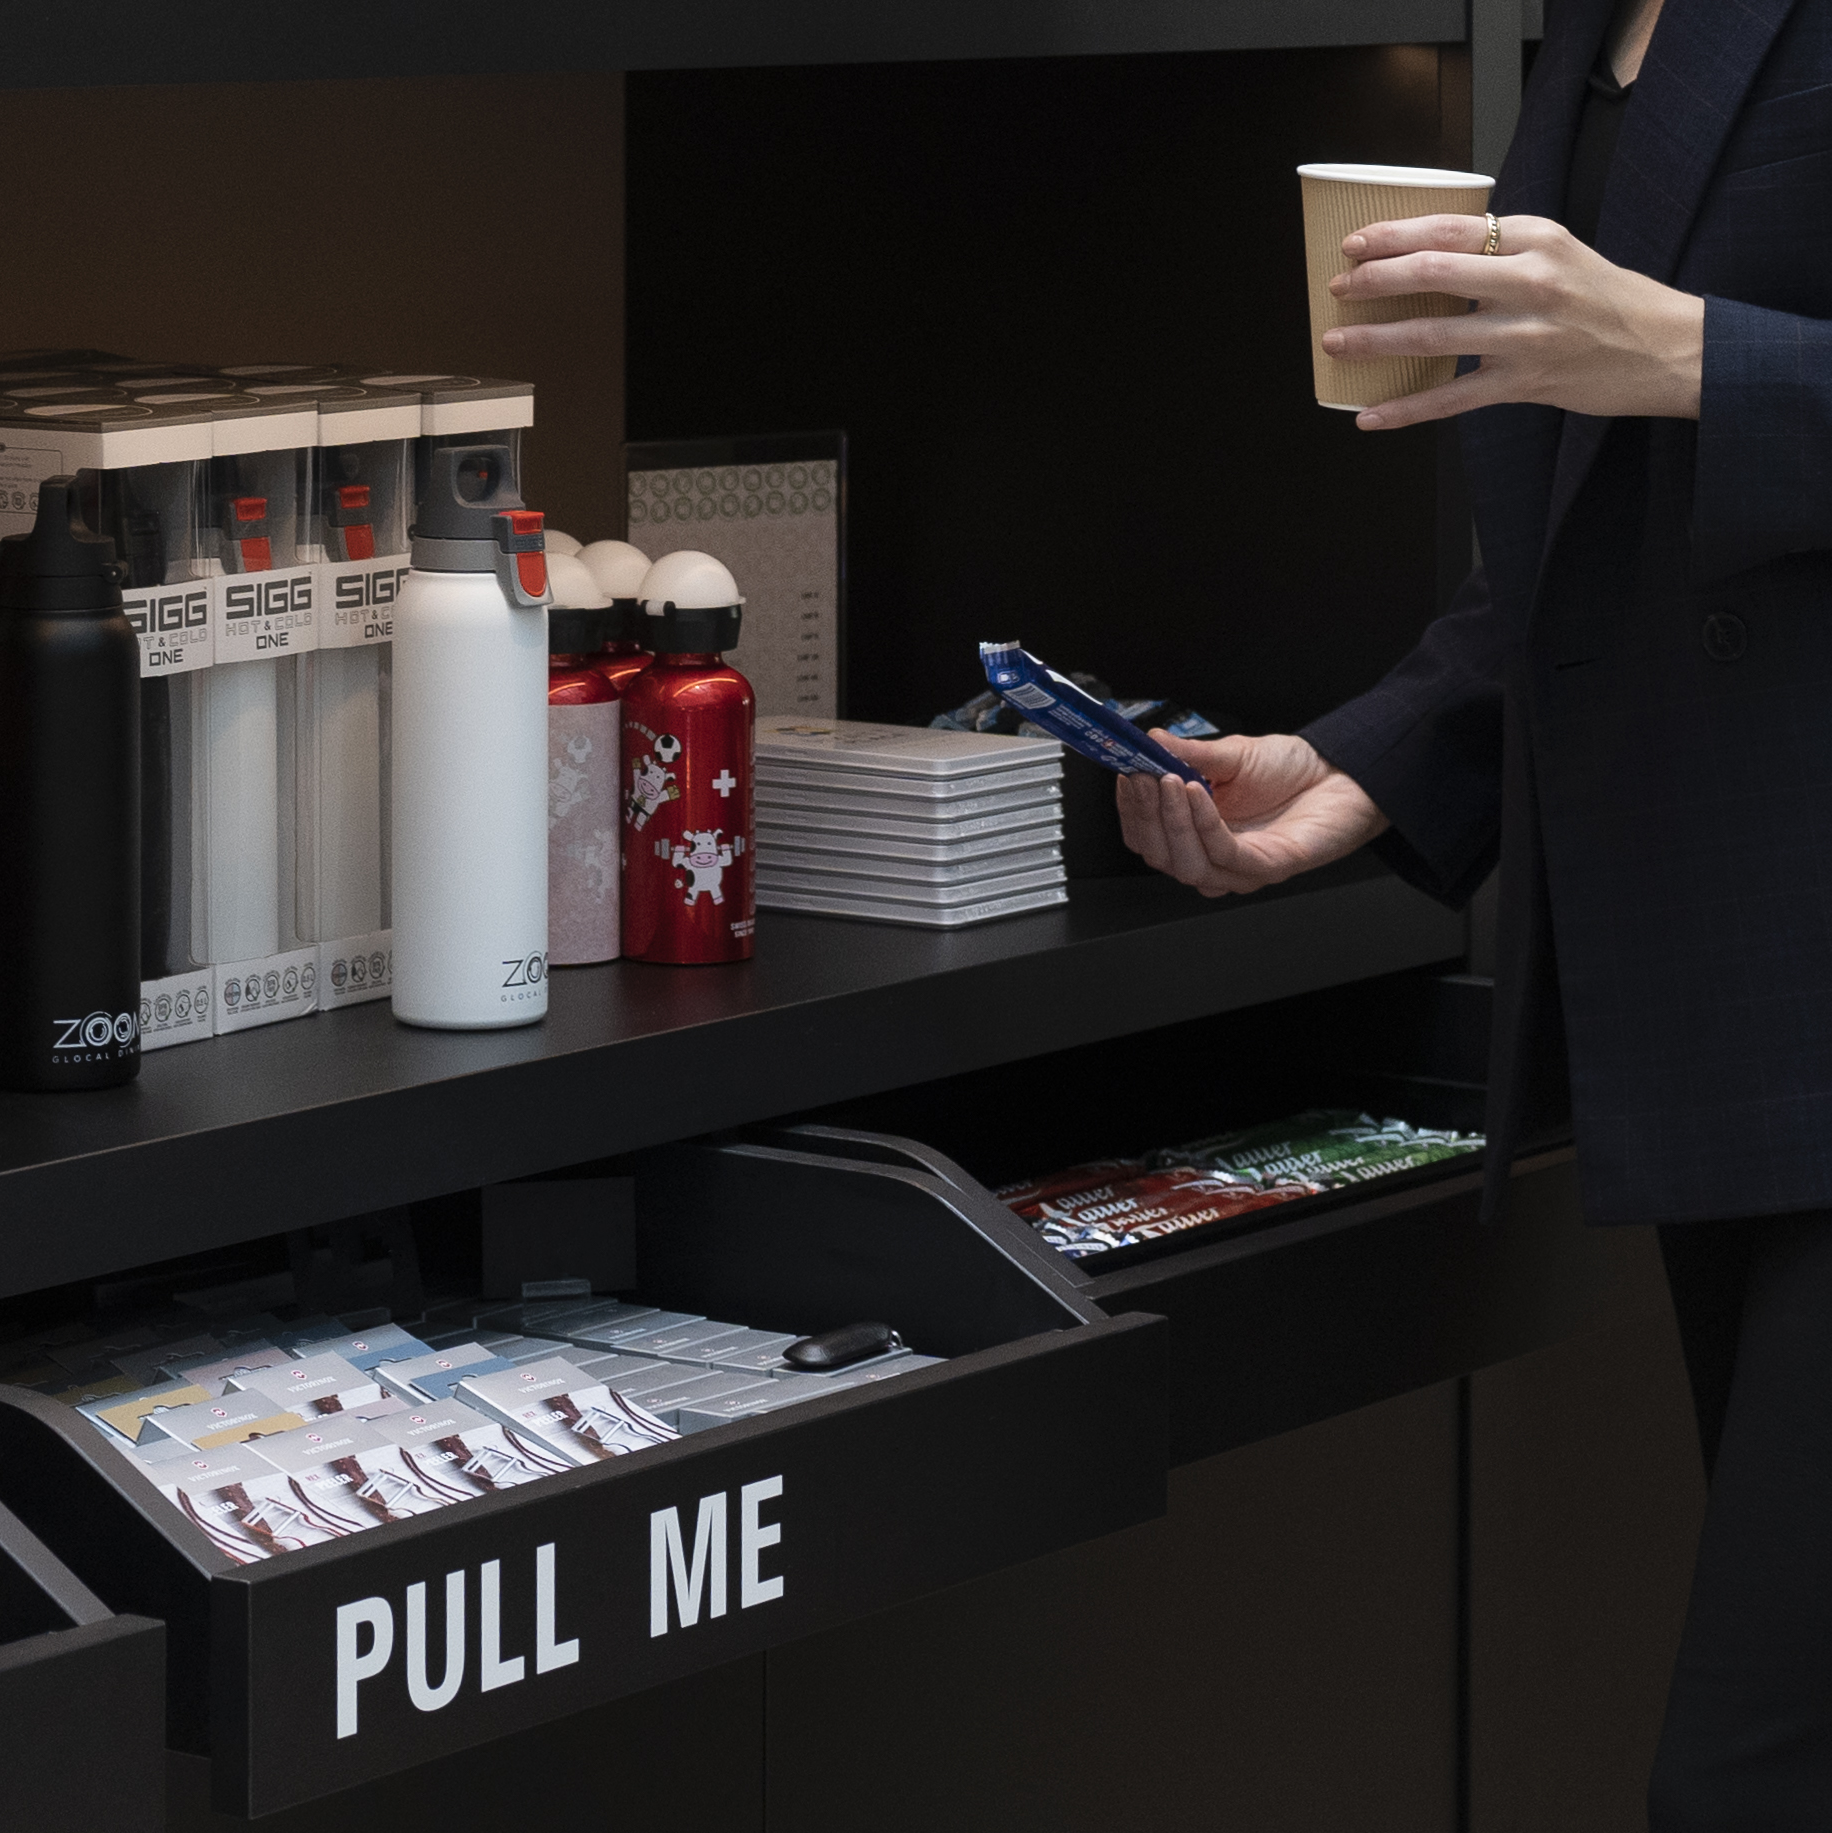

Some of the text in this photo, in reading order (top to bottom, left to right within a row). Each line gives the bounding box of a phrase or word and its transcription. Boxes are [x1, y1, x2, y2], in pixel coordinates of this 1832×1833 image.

[226, 576, 312, 620] SIGG
[122, 591, 207, 634] SIGG
[335, 609, 378, 626] HOT &
[225, 612, 312, 637] HOT & COLD
[365, 621, 393, 638] ONE
[158, 628, 207, 647] & COLD
[256, 632, 289, 650] ONE
[149, 649, 183, 667] ONE
[500, 989, 542, 1003] GLOCAL
[52, 1052, 110, 1064] GLOCAL
[530, 1410, 569, 1428] PEELER
[423, 1451, 459, 1466] PEELER
[314, 1473, 354, 1490] PEELER
[336, 1475, 784, 1739] PULL ME
